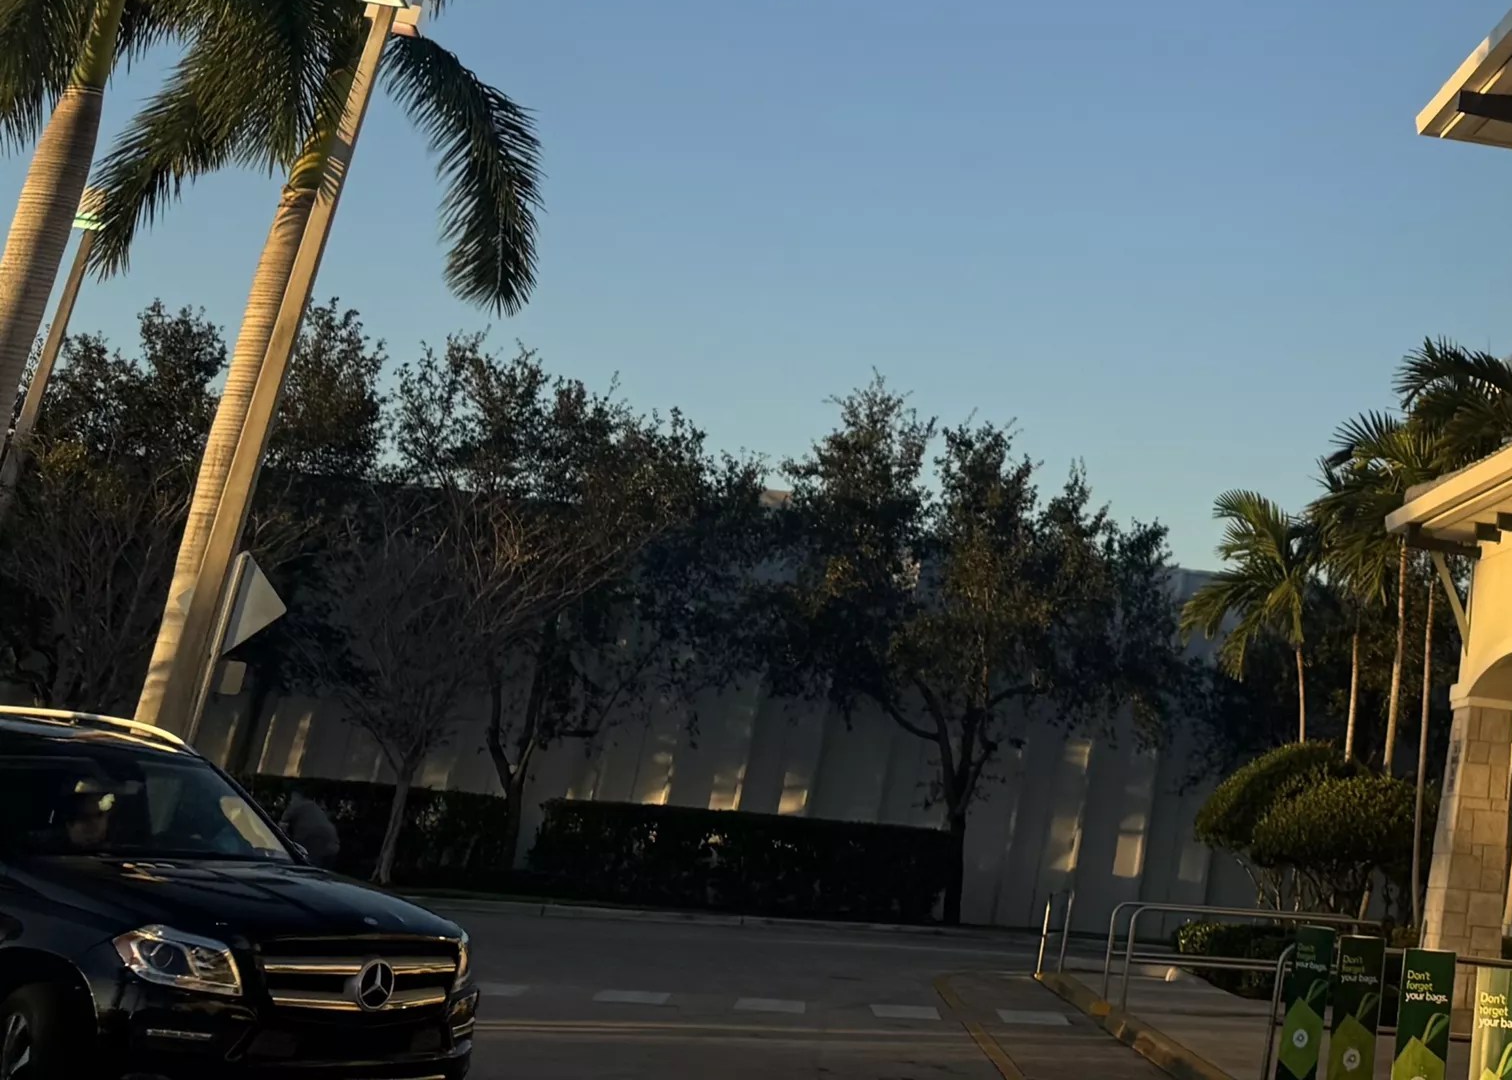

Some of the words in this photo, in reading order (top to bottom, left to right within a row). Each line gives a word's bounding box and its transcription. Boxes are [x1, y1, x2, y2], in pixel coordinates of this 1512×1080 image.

[1341, 974, 1358, 983] your
[1407, 970, 1431, 980] Don't
[1407, 981, 1433, 992] forget
[1405, 992, 1425, 1002] your
[1425, 992, 1448, 1004] bags.
[1480, 992, 1506, 1005] Don't
[1480, 1004, 1508, 1018] forget
[1478, 1017, 1500, 1028] your
